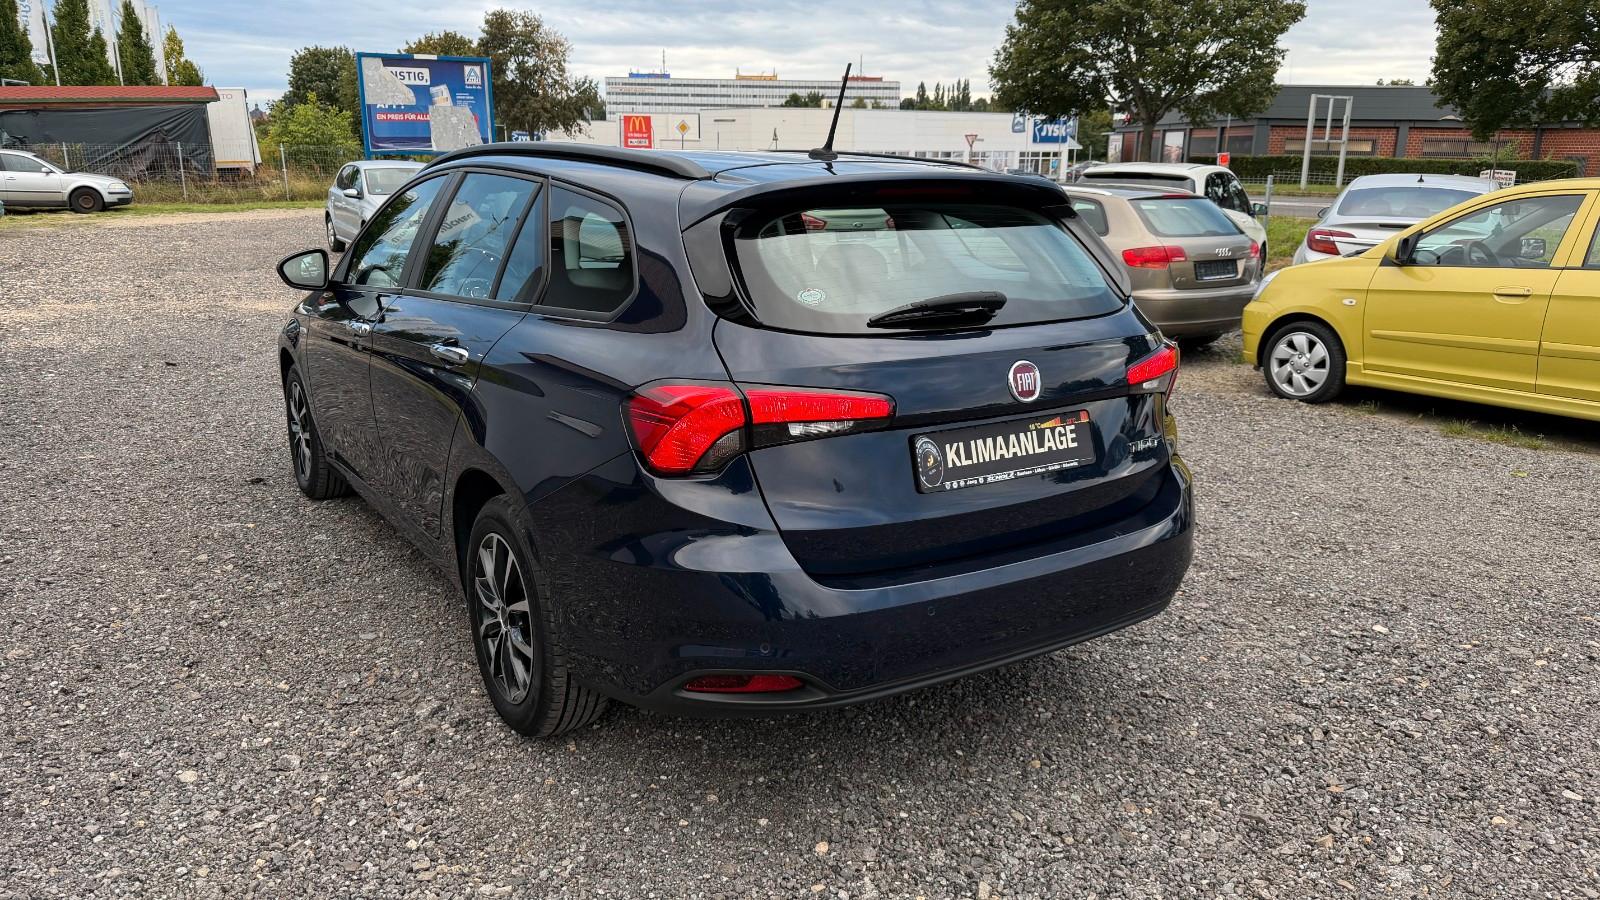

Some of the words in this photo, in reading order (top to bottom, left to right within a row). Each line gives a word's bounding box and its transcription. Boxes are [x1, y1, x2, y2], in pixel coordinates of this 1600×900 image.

[404, 112, 417, 120] FÜR
[1041, 124, 1066, 136] JYSK
[1016, 372, 1035, 392] FIAT
[945, 424, 1078, 468] KLIMAANLAGE
